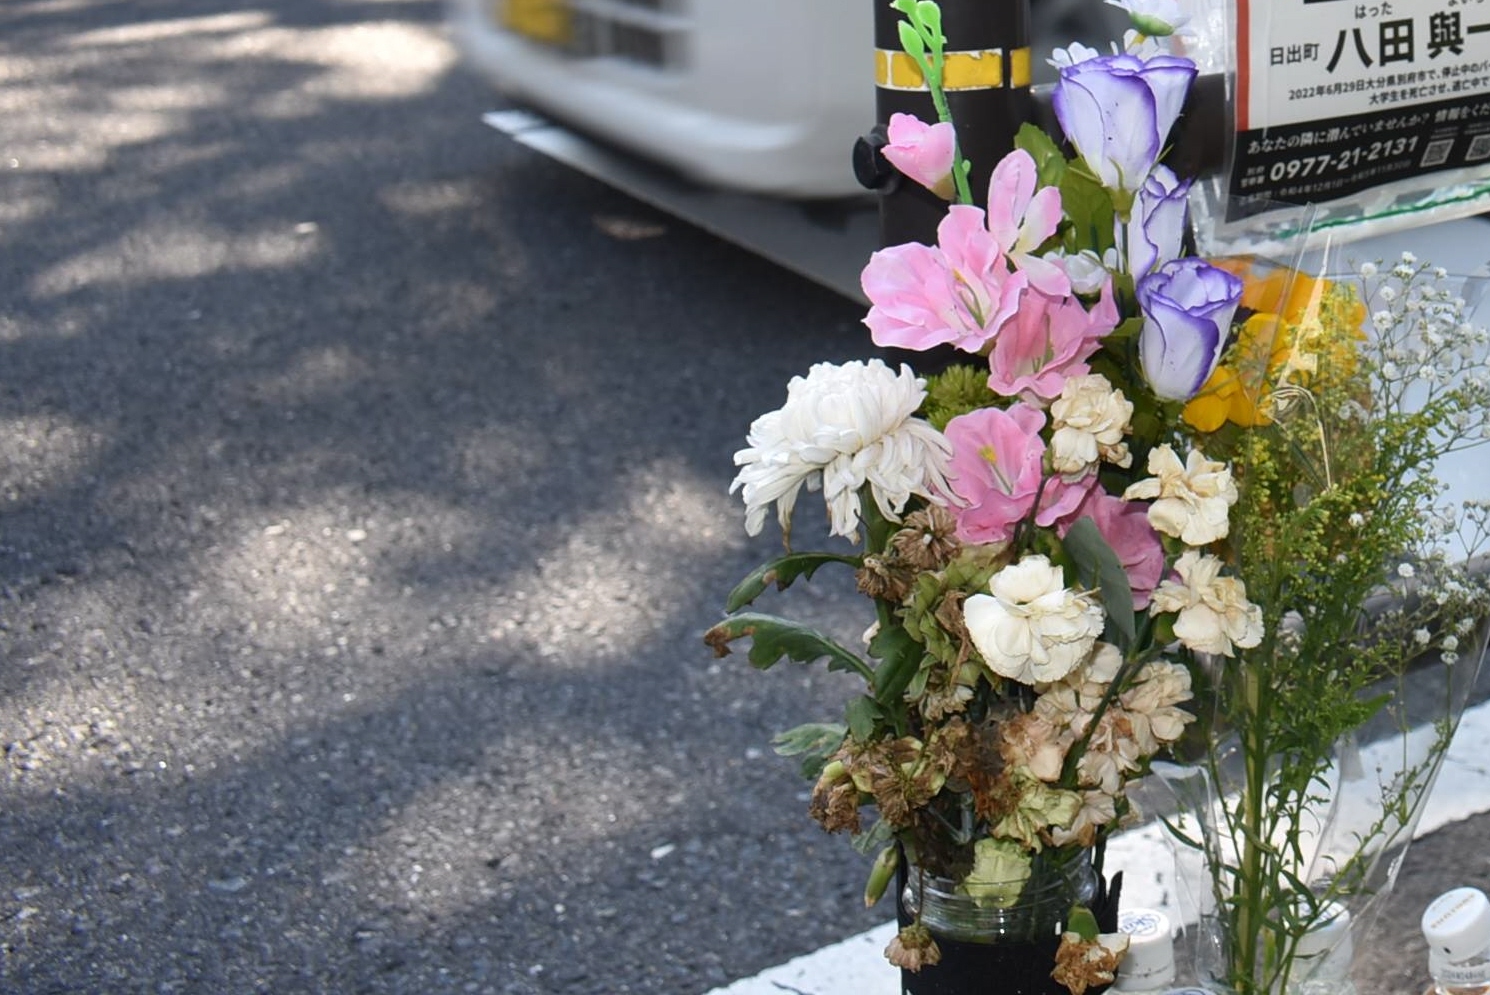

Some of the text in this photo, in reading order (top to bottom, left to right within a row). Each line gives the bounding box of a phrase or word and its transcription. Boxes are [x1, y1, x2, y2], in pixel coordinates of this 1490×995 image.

[1354, 1, 1393, 19] はった
[1270, 43, 1320, 66] 日出町
[1326, 17, 1415, 73] 八田
[1270, 135, 1419, 182] 0977-21-2131
